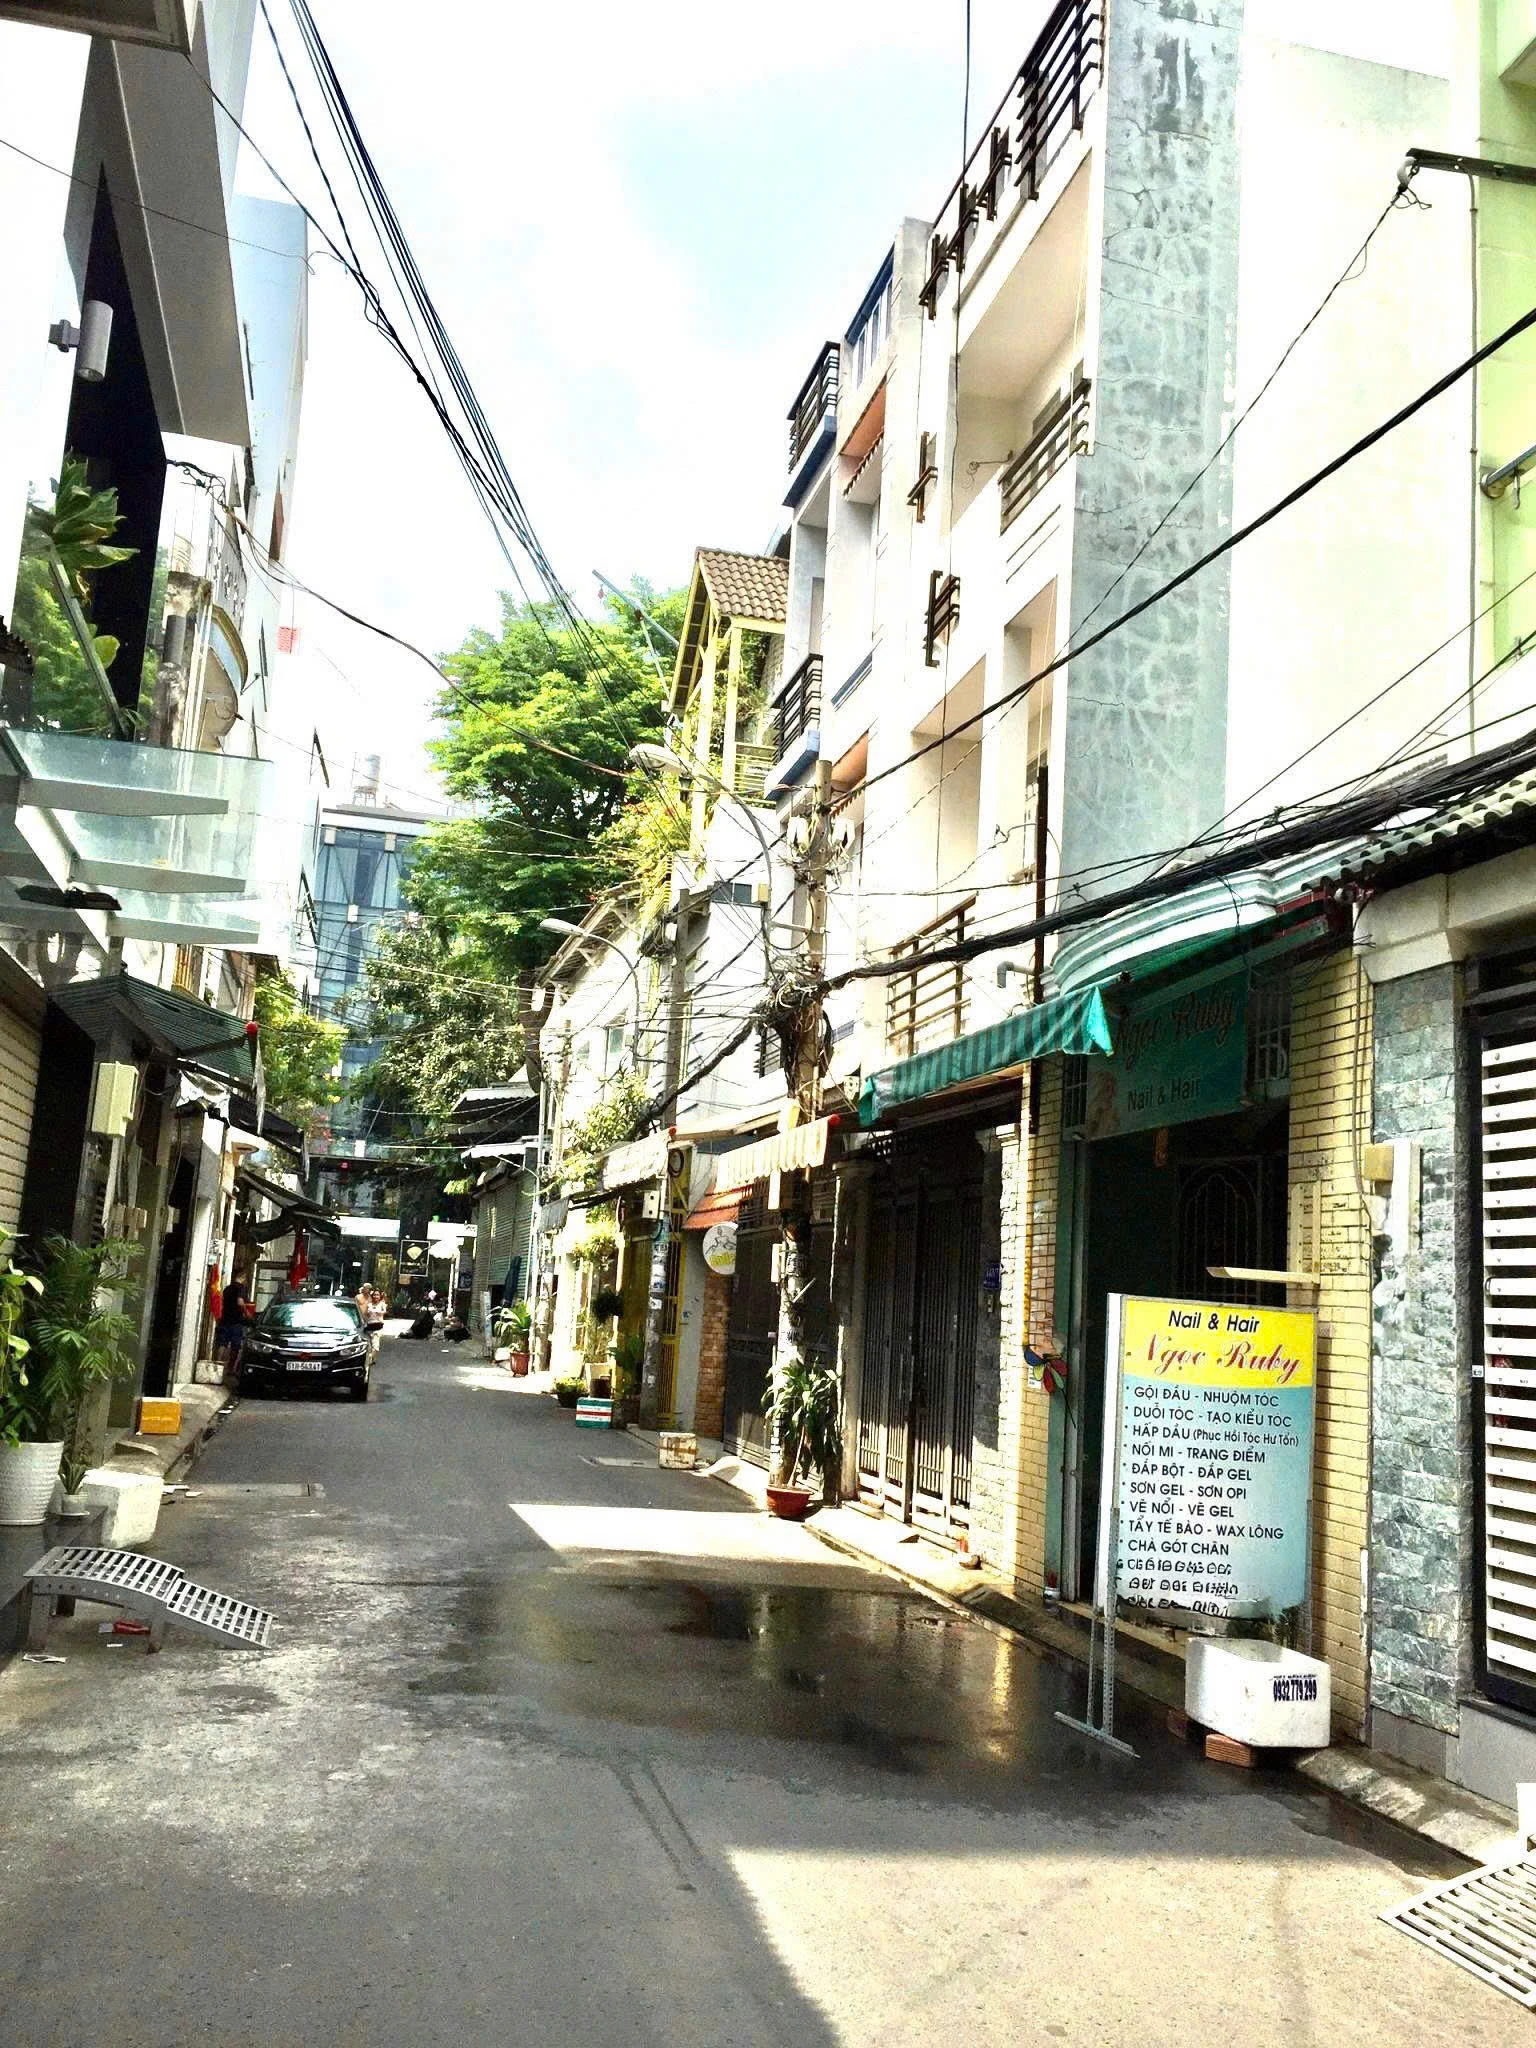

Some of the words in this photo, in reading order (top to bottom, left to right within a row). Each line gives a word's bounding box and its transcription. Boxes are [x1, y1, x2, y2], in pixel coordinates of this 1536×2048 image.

[1128, 1087, 1153, 1112] Nail
[1171, 1079, 1200, 1102] Hair
[1169, 1310, 1201, 1328] Nail
[1208, 1313, 1219, 1330] &
[1227, 1315, 1259, 1332] Hair
[1217, 1341, 1300, 1384] Ruby
[1204, 1391, 1251, 1406] NHUỘM
[1255, 1392, 1279, 1407] TÓC
[1169, 1409, 1194, 1421] TÓC
[1207, 1411, 1231, 1424] TẠO
[1235, 1408, 1263, 1425] KIỂU
[1268, 1415, 1291, 1427] TÓC
[1133, 1423, 1158, 1437] HẤP
[1242, 1432, 1260, 1444] Tóc
[1263, 1433, 1277, 1444] Hư
[1132, 1441, 1154, 1456] NỐI
[1159, 1446, 1173, 1457] MI
[1187, 1448, 1229, 1460] TRANG
[1233, 1446, 1265, 1463] ĐIỂM
[1132, 1459, 1158, 1475] ĐẮP
[1162, 1463, 1184, 1478] BỘT
[1198, 1462, 1223, 1479] ĐẮP
[1227, 1469, 1252, 1481] GEL
[1130, 1481, 1155, 1494] SƠN
[1160, 1484, 1184, 1496] GEL
[1198, 1485, 1222, 1498] SƠN
[1227, 1488, 1246, 1499] OPI
[1130, 1499, 1146, 1512] VẼ
[1152, 1497, 1174, 1514] NỔI
[1188, 1503, 1204, 1516] VẼ
[1209, 1506, 1234, 1517] GEL
[1129, 1515, 1153, 1532] TẨY
[1158, 1518, 1172, 1533] TẾ
[1177, 1520, 1203, 1535] BÀO
[1216, 1525, 1245, 1537] WAX
[1249, 1524, 1284, 1539] LÔNG
[1128, 1537, 1156, 1552] CHÀ
[1161, 1539, 1188, 1553] GÓT
[1191, 1541, 1228, 1556] CHÂN
